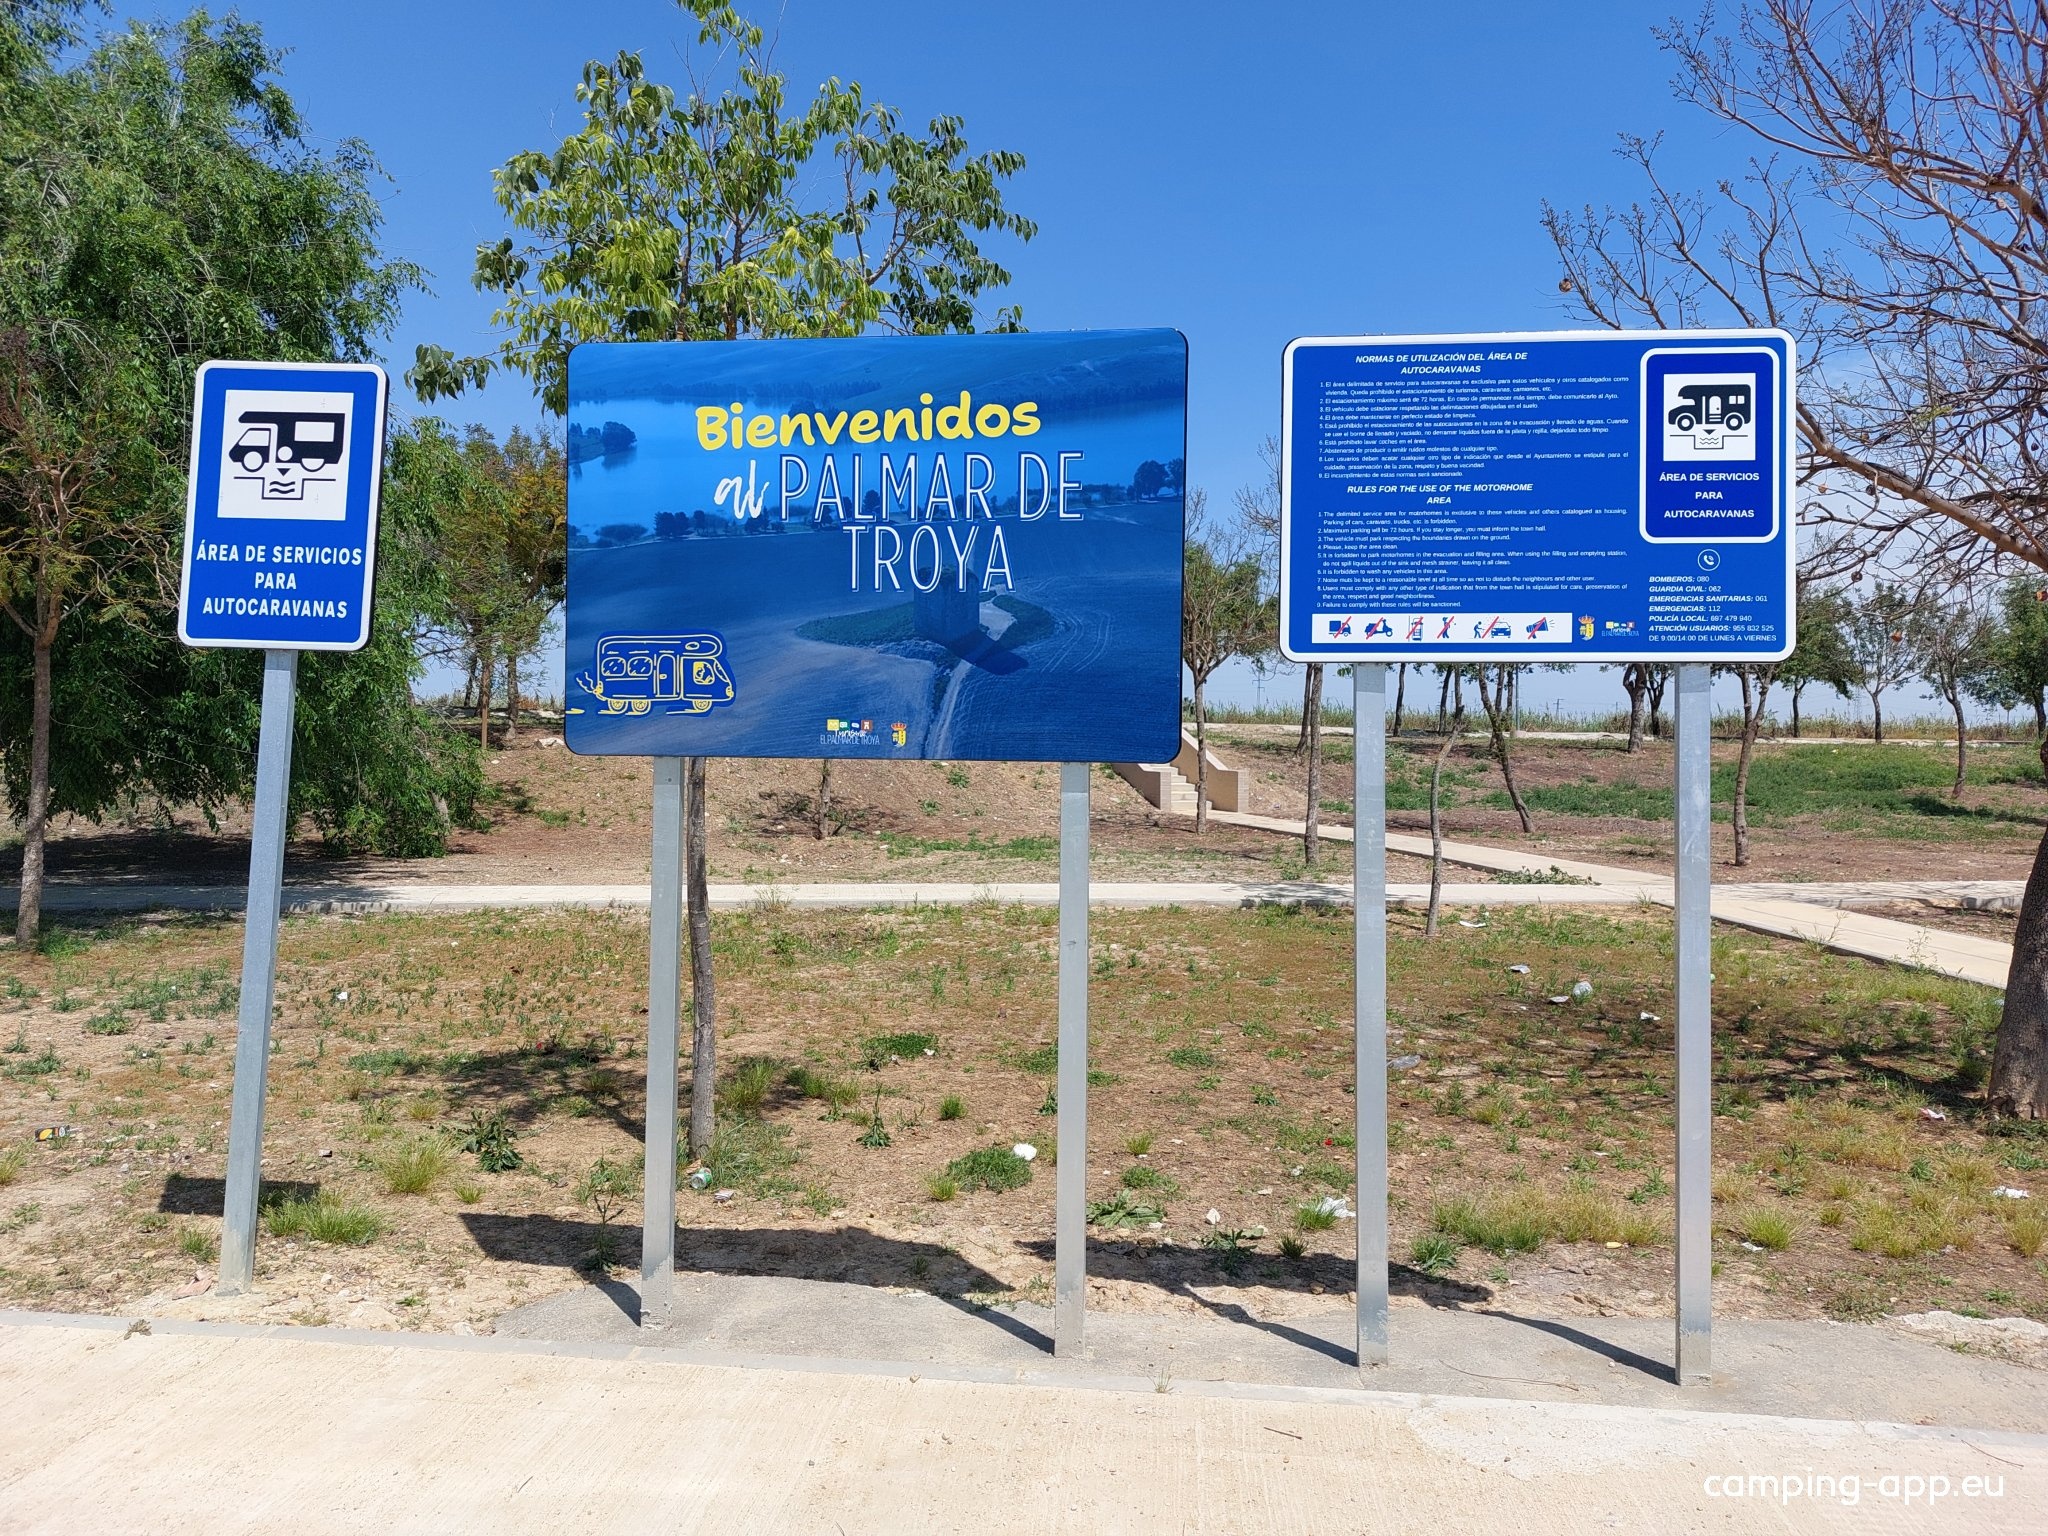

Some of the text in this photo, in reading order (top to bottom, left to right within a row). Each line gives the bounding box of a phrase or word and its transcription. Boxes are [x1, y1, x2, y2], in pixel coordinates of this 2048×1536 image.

[1356, 355, 1394, 363] NORMAS
[1411, 352, 1466, 362] UTILIZACIÓN
[1488, 352, 1512, 360] ÁREA
[1401, 366, 1480, 374] AUTOCARAVANAS
[695, 390, 1042, 451] Bienvenidos
[1659, 472, 1759, 481] ÁREA DE SERVICIOS
[779, 452, 996, 523] PALMAR
[1018, 450, 1085, 522] DE
[1664, 510, 1754, 518] AUTOCARAVANAS
[197, 540, 361, 565] ÁREA DE SERVICIOS
[842, 524, 1017, 593] TROYA
[255, 572, 296, 589] PARA
[203, 598, 347, 618] AUTOCARAVANAS
